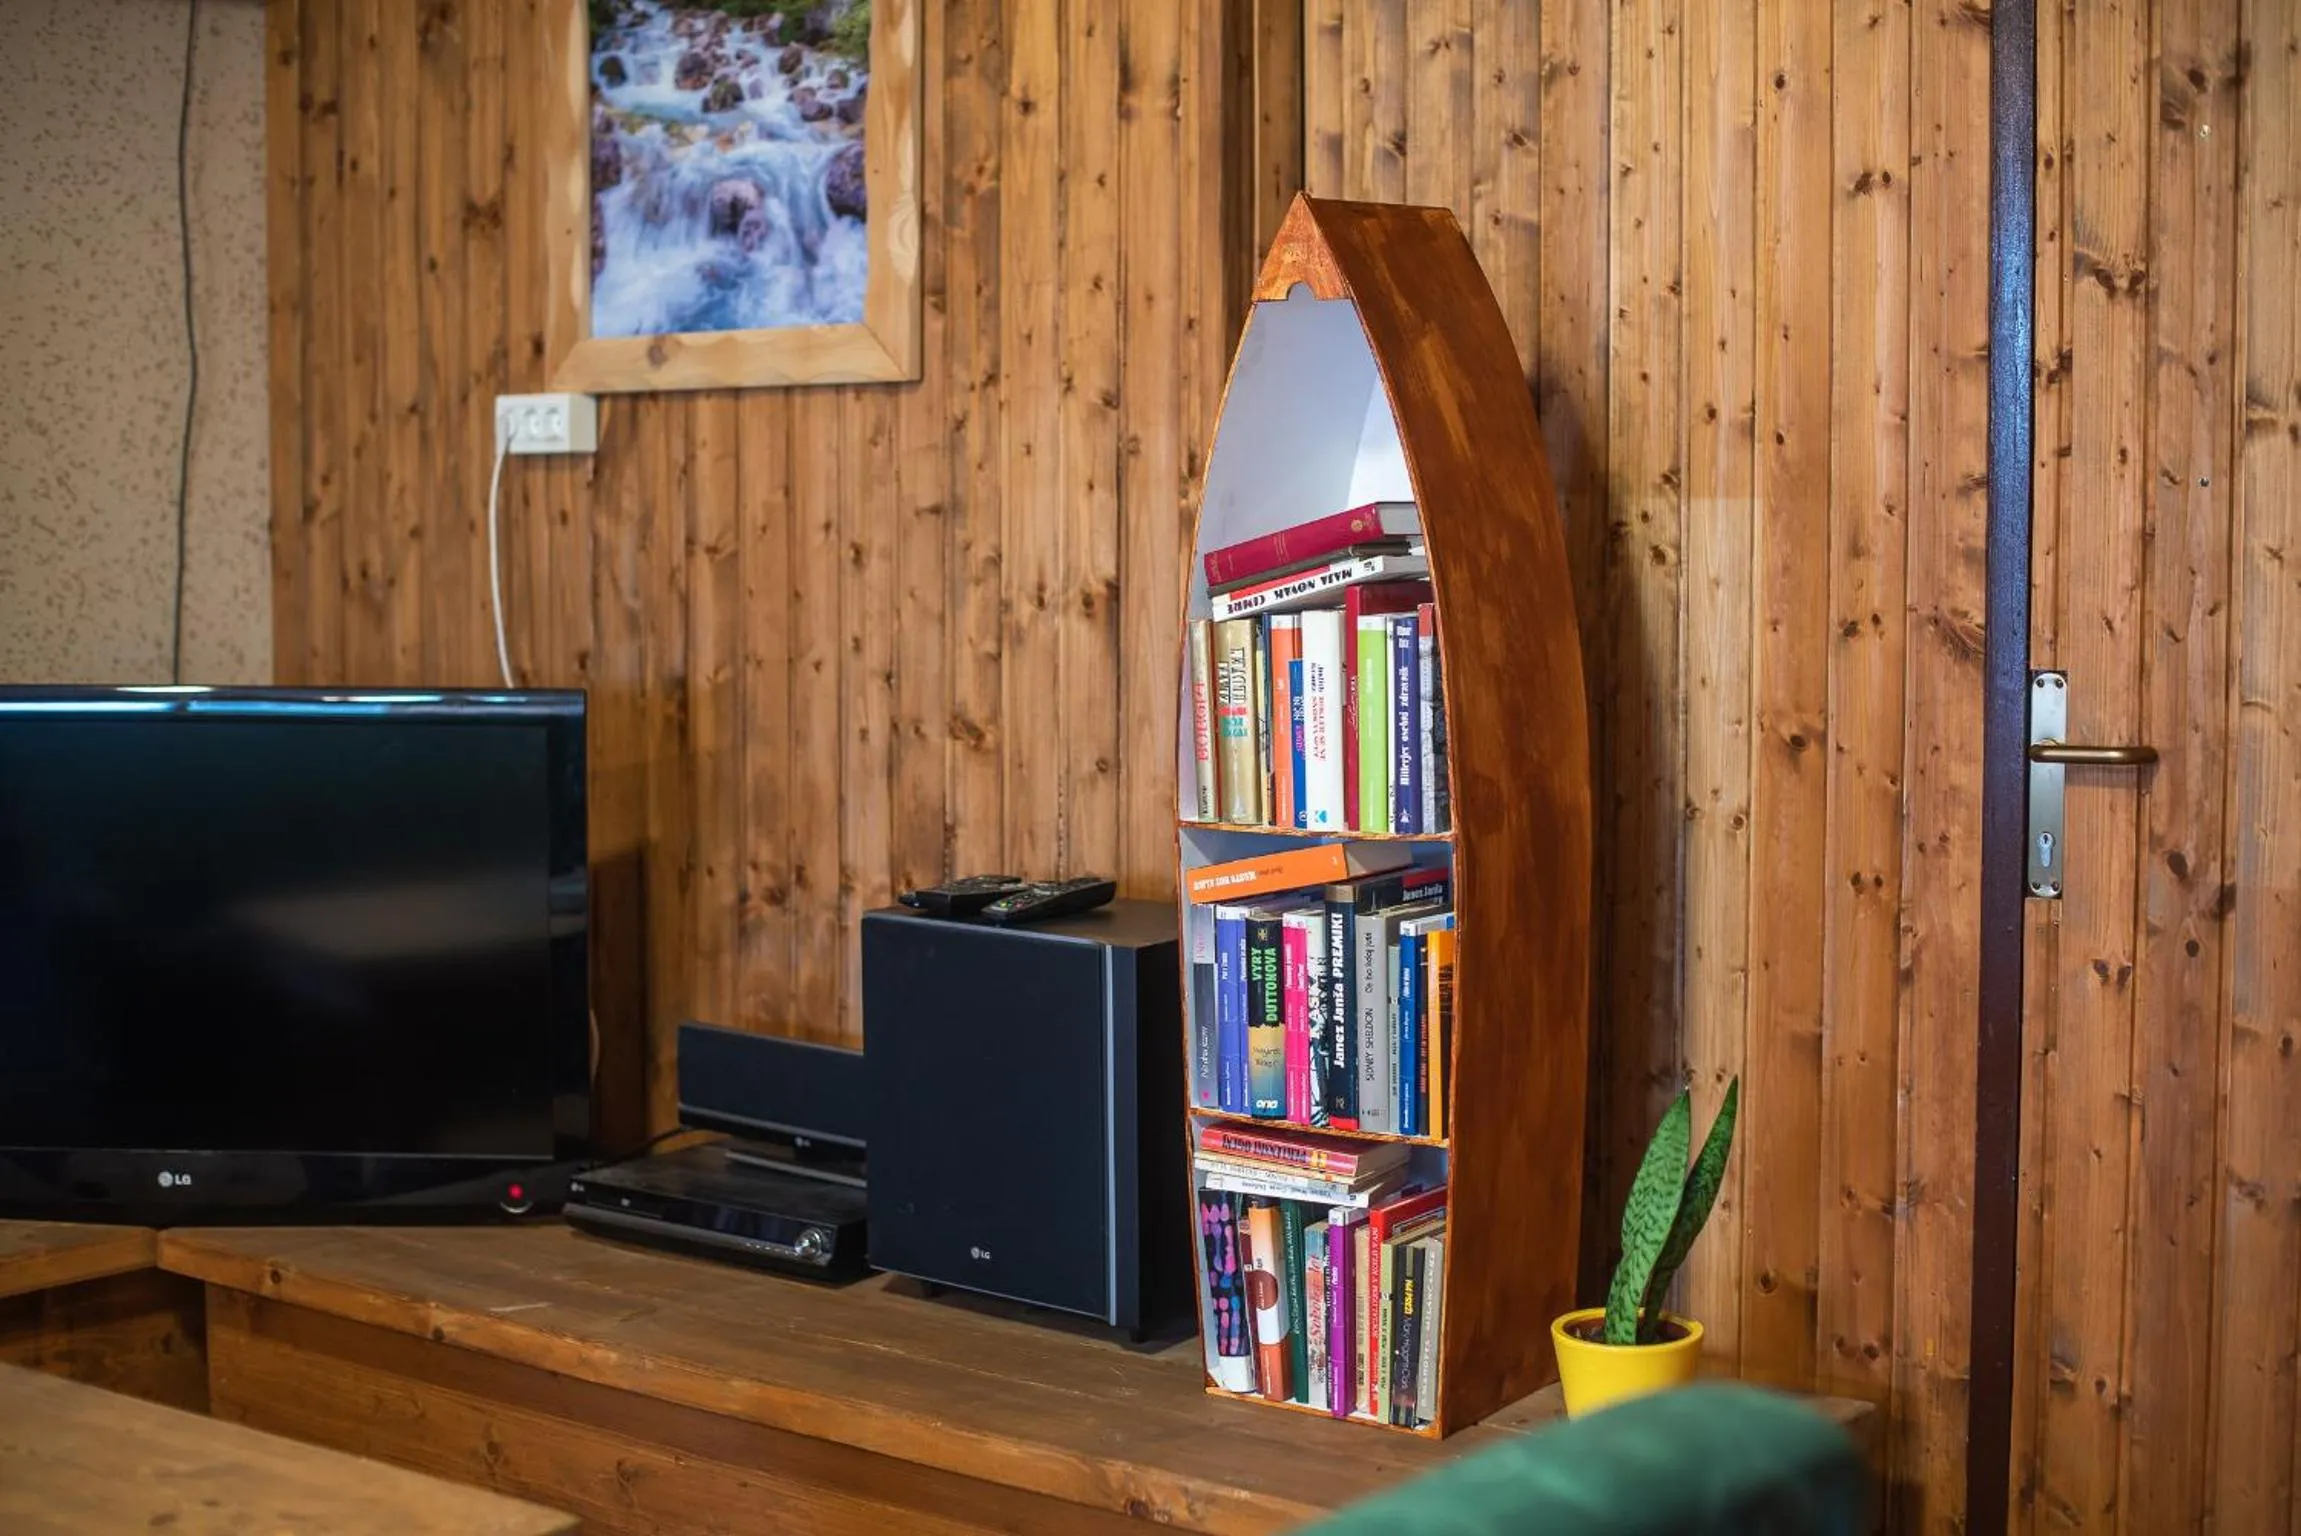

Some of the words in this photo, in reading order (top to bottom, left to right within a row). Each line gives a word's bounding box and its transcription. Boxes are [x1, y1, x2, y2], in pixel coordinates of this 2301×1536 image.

[1274, 579, 1316, 600] NOVAK
[1322, 567, 1353, 587] MAJA
[1251, 947, 1263, 981] VYRY
[1331, 912, 1345, 978] PREMIKI
[1264, 946, 1277, 1022] DUTTONOVA
[1332, 982, 1345, 1023] Janša
[1332, 1024, 1345, 1069] Janez
[1364, 1007, 1375, 1049] SHELDON
[1364, 1051, 1375, 1081] SIDNEY
